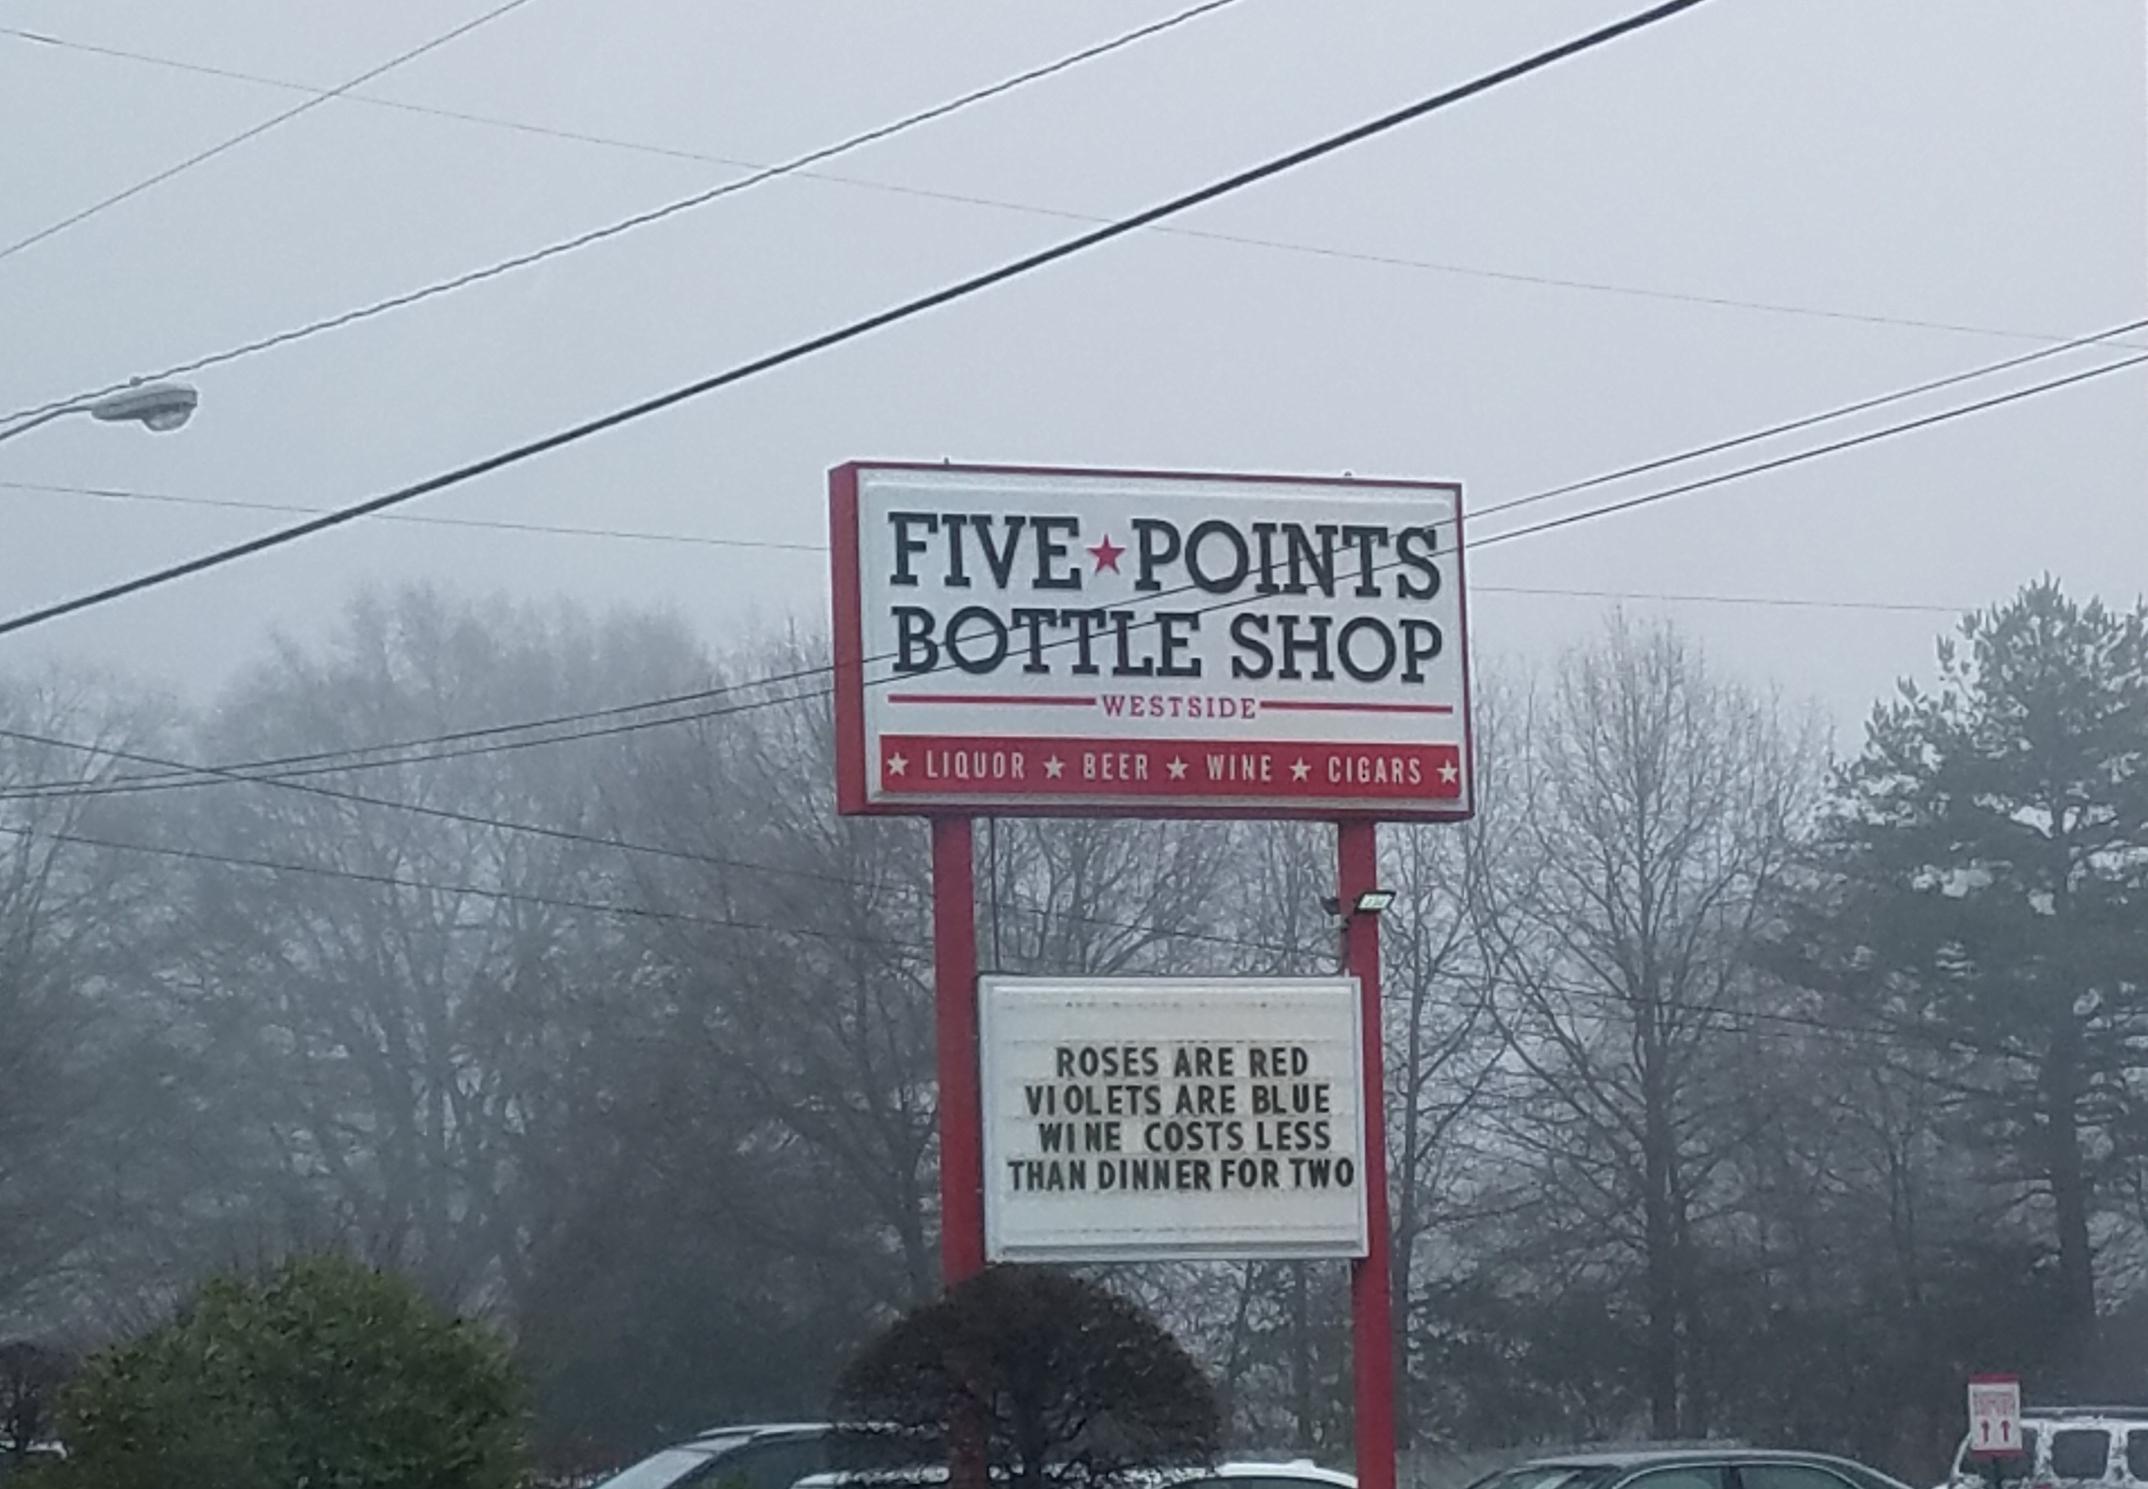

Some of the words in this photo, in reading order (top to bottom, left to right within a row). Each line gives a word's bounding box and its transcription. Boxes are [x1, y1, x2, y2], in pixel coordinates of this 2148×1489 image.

[888, 511, 1082, 590] FIVE
[1131, 518, 1441, 600] POINTS
[891, 604, 1202, 678] BOTTLE
[1230, 613, 1443, 683] SHOP
[1103, 694, 1257, 720] WESTSIDE
[926, 750, 1026, 780] LIQUOR
[1083, 753, 1149, 781] BEER
[1206, 753, 1272, 782] WINE
[1328, 756, 1422, 785] CIGARS
[1056, 1046, 1159, 1078] ROSES
[1173, 1046, 1234, 1078] ARE
[1249, 1046, 1309, 1077] RED
[1025, 1084, 1161, 1116] VIOLETS
[1175, 1084, 1236, 1115] ARE
[1251, 1084, 1331, 1114] BLUE
[1038, 1121, 1122, 1153] WINE
[1144, 1121, 1244, 1152] COSTS
[1256, 1121, 1331, 1152] LESS
[1007, 1159, 1087, 1191] THAN
[1098, 1158, 1211, 1191] DINNER
[1221, 1158, 1279, 1189] FOR
[1289, 1157, 1354, 1188] TWO
